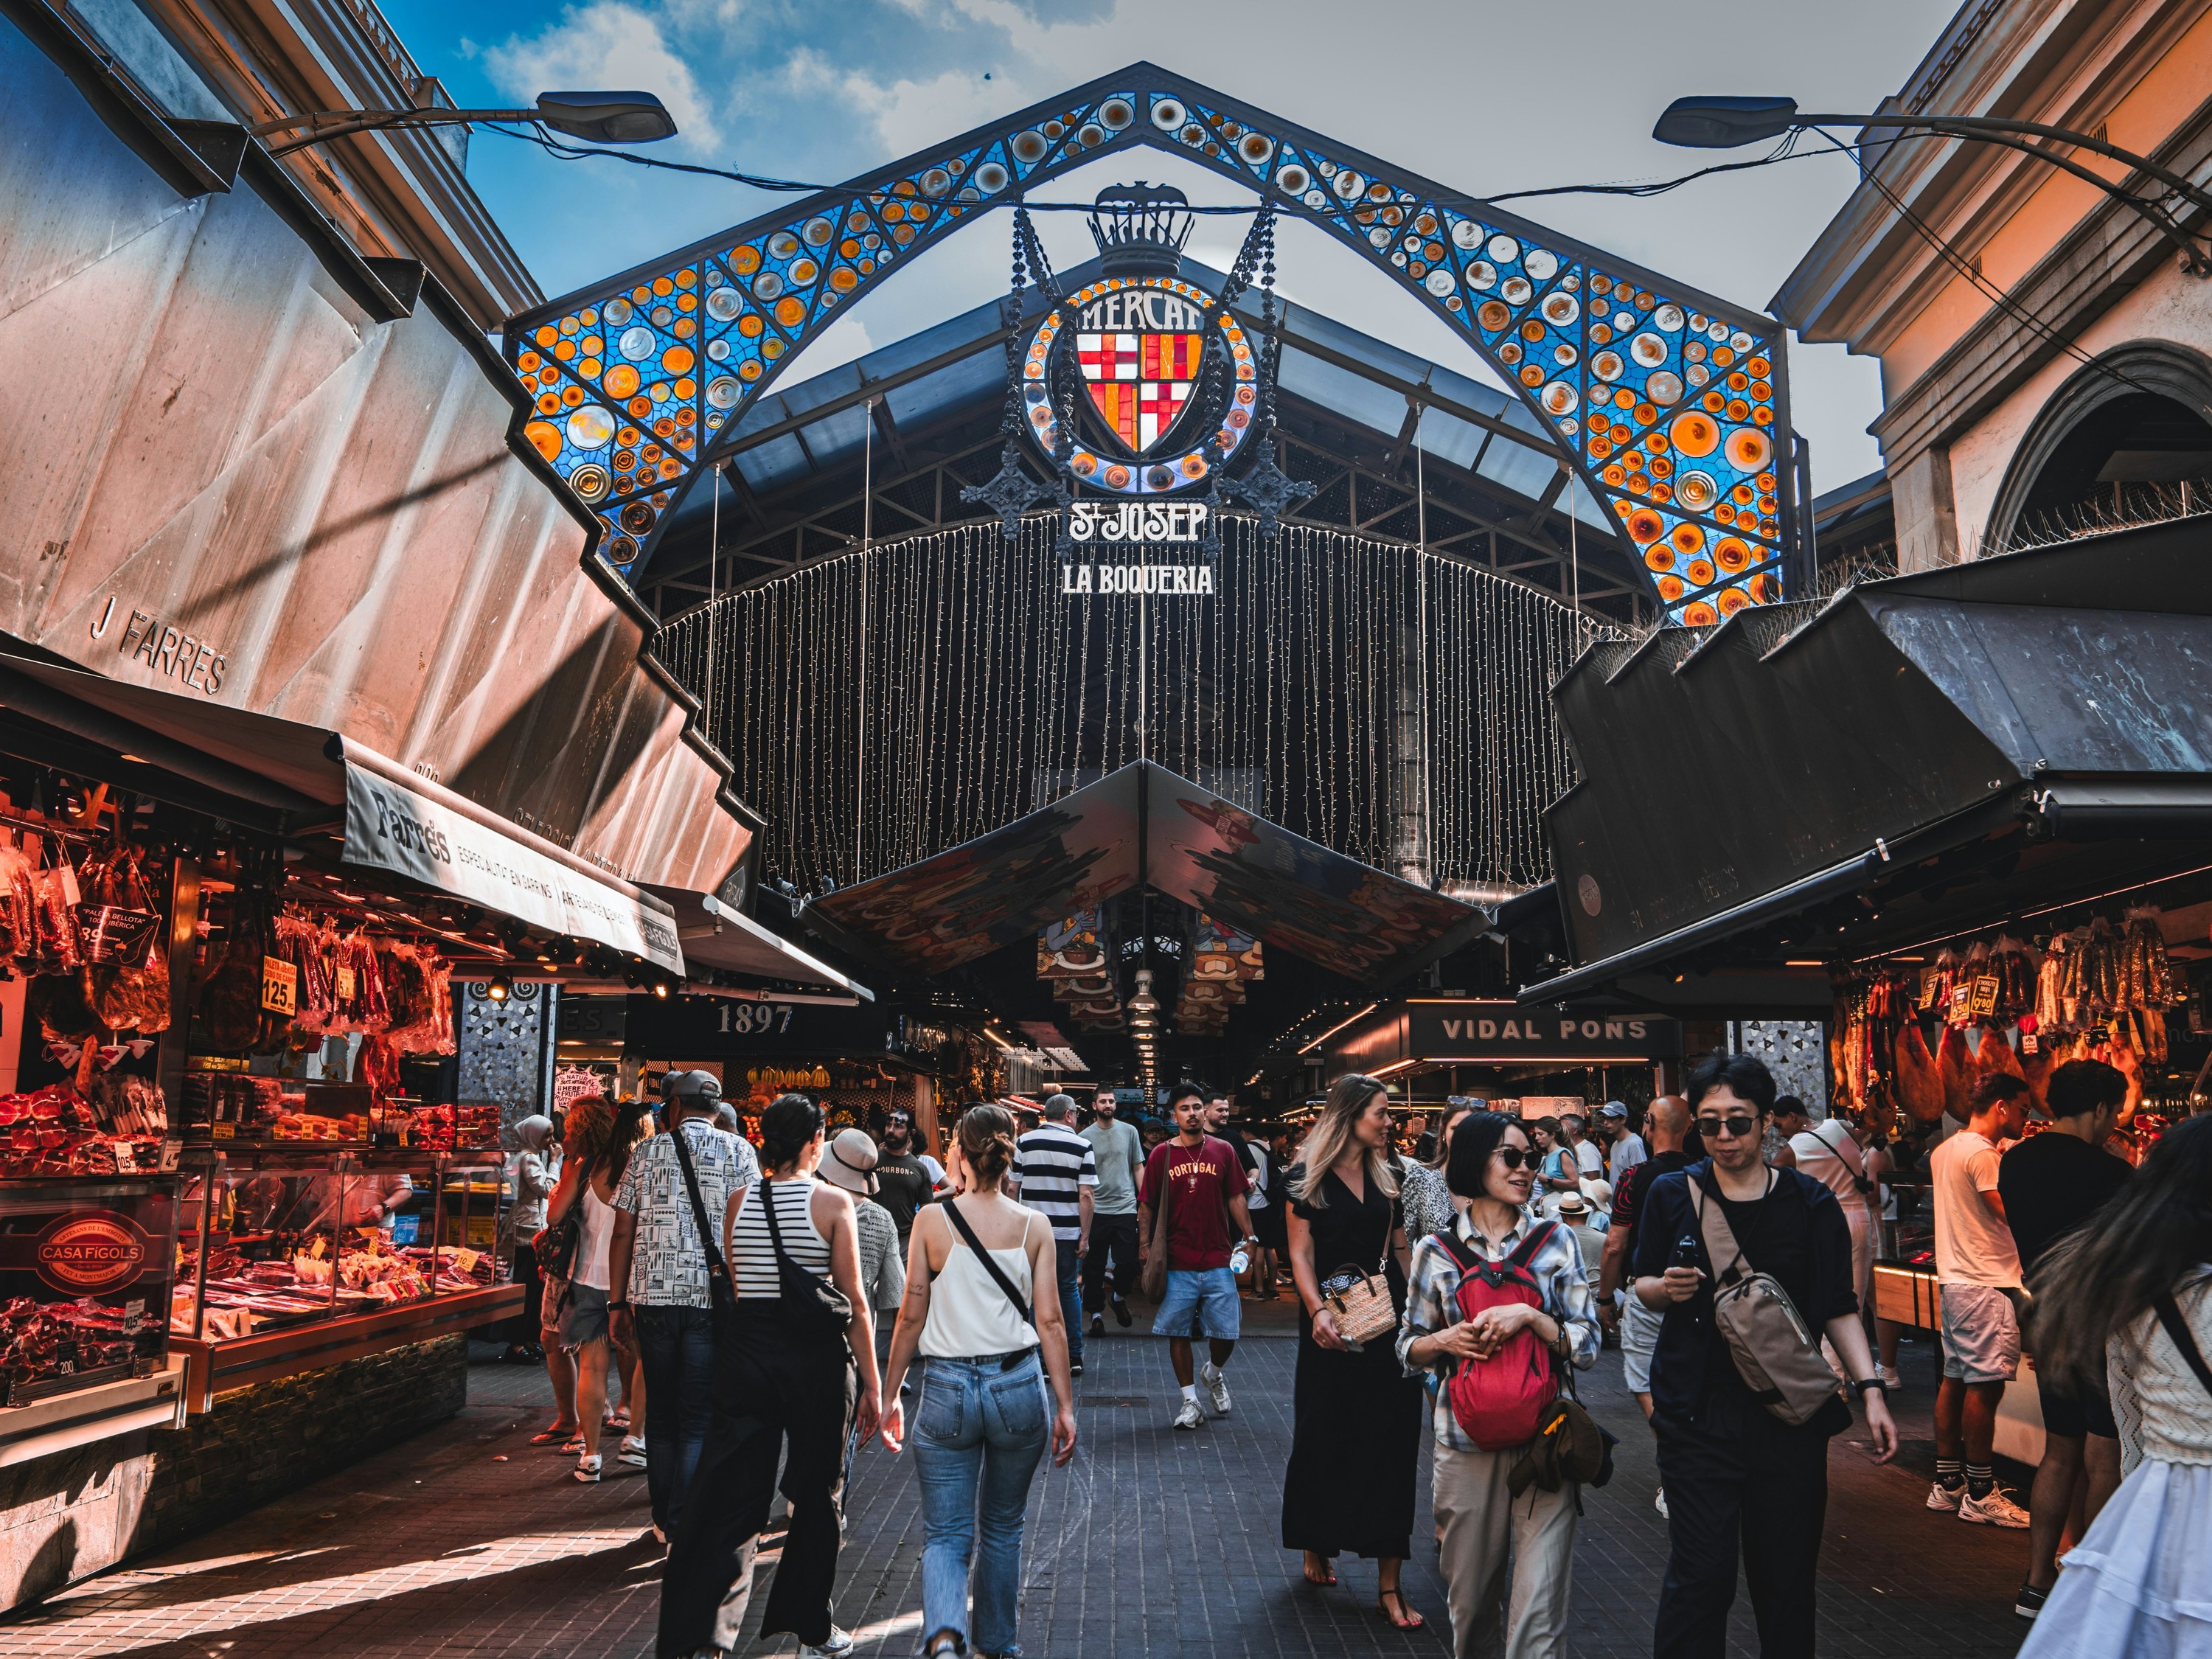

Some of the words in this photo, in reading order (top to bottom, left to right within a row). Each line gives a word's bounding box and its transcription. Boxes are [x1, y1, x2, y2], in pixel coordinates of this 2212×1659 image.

[1082, 291, 1201, 330] MERCAT
[1101, 503, 1208, 541] JOSEP
[1063, 566, 1091, 594] LA
[1099, 565, 1214, 594] BOQUERIA
[91, 596, 116, 639] J
[120, 610, 227, 695] FARRES
[262, 978, 288, 1007] 125
[717, 1004, 793, 1034] 1897
[1442, 1020, 1542, 1040] VIDAL
[1560, 1020, 1647, 1040] PONS
[59, 1226, 87, 1242] ARTESANS
[42, 1247, 83, 1259] CASA
[63, 1267, 73, 1276] FET
[79, 1267, 116, 1279] MONTMAJOR
[60, 1360, 74, 1374] 200
